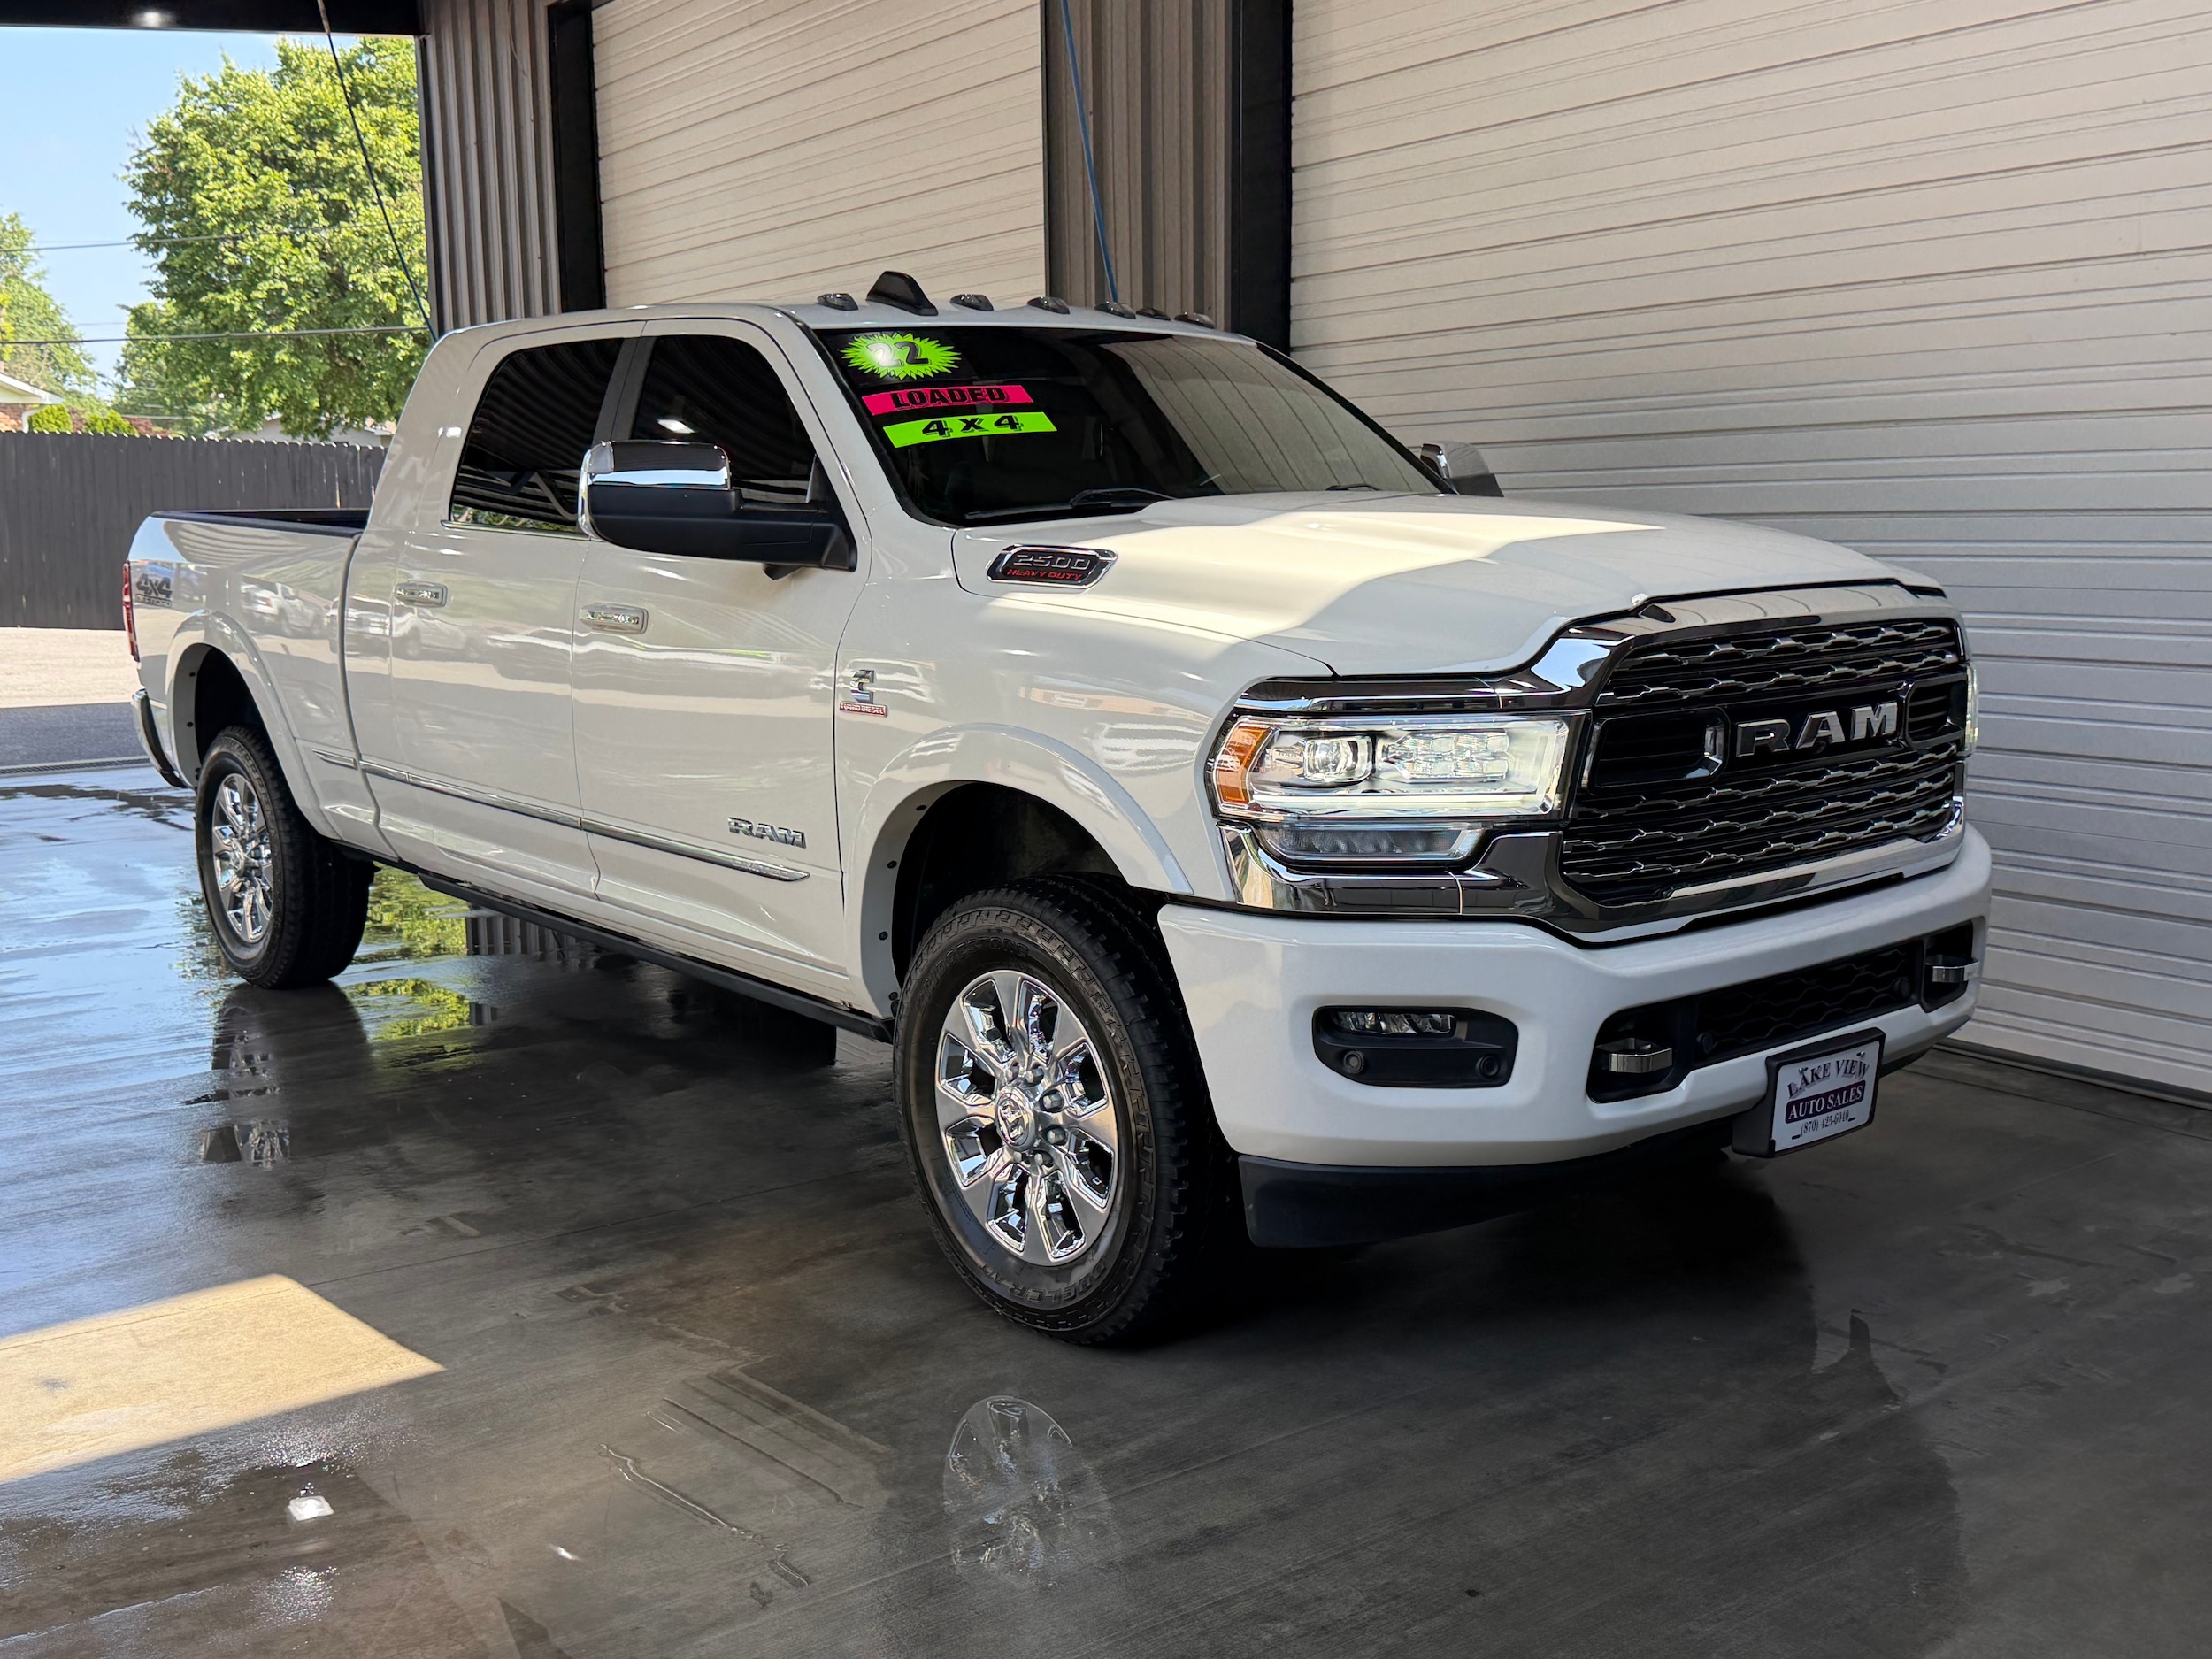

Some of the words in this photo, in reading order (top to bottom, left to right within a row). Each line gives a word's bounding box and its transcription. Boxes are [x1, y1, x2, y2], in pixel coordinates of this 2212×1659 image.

[867, 342, 931, 367] 22
[891, 386, 1010, 410] LOADED
[1007, 569, 1047, 578] HEAVY
[1047, 572, 1083, 580] DUTY
[1014, 554, 1090, 570] 2500
[861, 705, 886, 715] DIESEL
[1736, 702, 1898, 758] RAM
[727, 817, 807, 849] RAM
[916, 936, 1029, 1016] BRIDGESTONE
[1787, 1062, 1831, 1099] LAKE
[1836, 1059, 1870, 1080] VIEW
[1788, 1097, 1825, 1120] AUTO
[1826, 1085, 1863, 1110] SALES
[1801, 1118, 1818, 1135] (870)
[1008, 1257, 1106, 1305] DUELER
